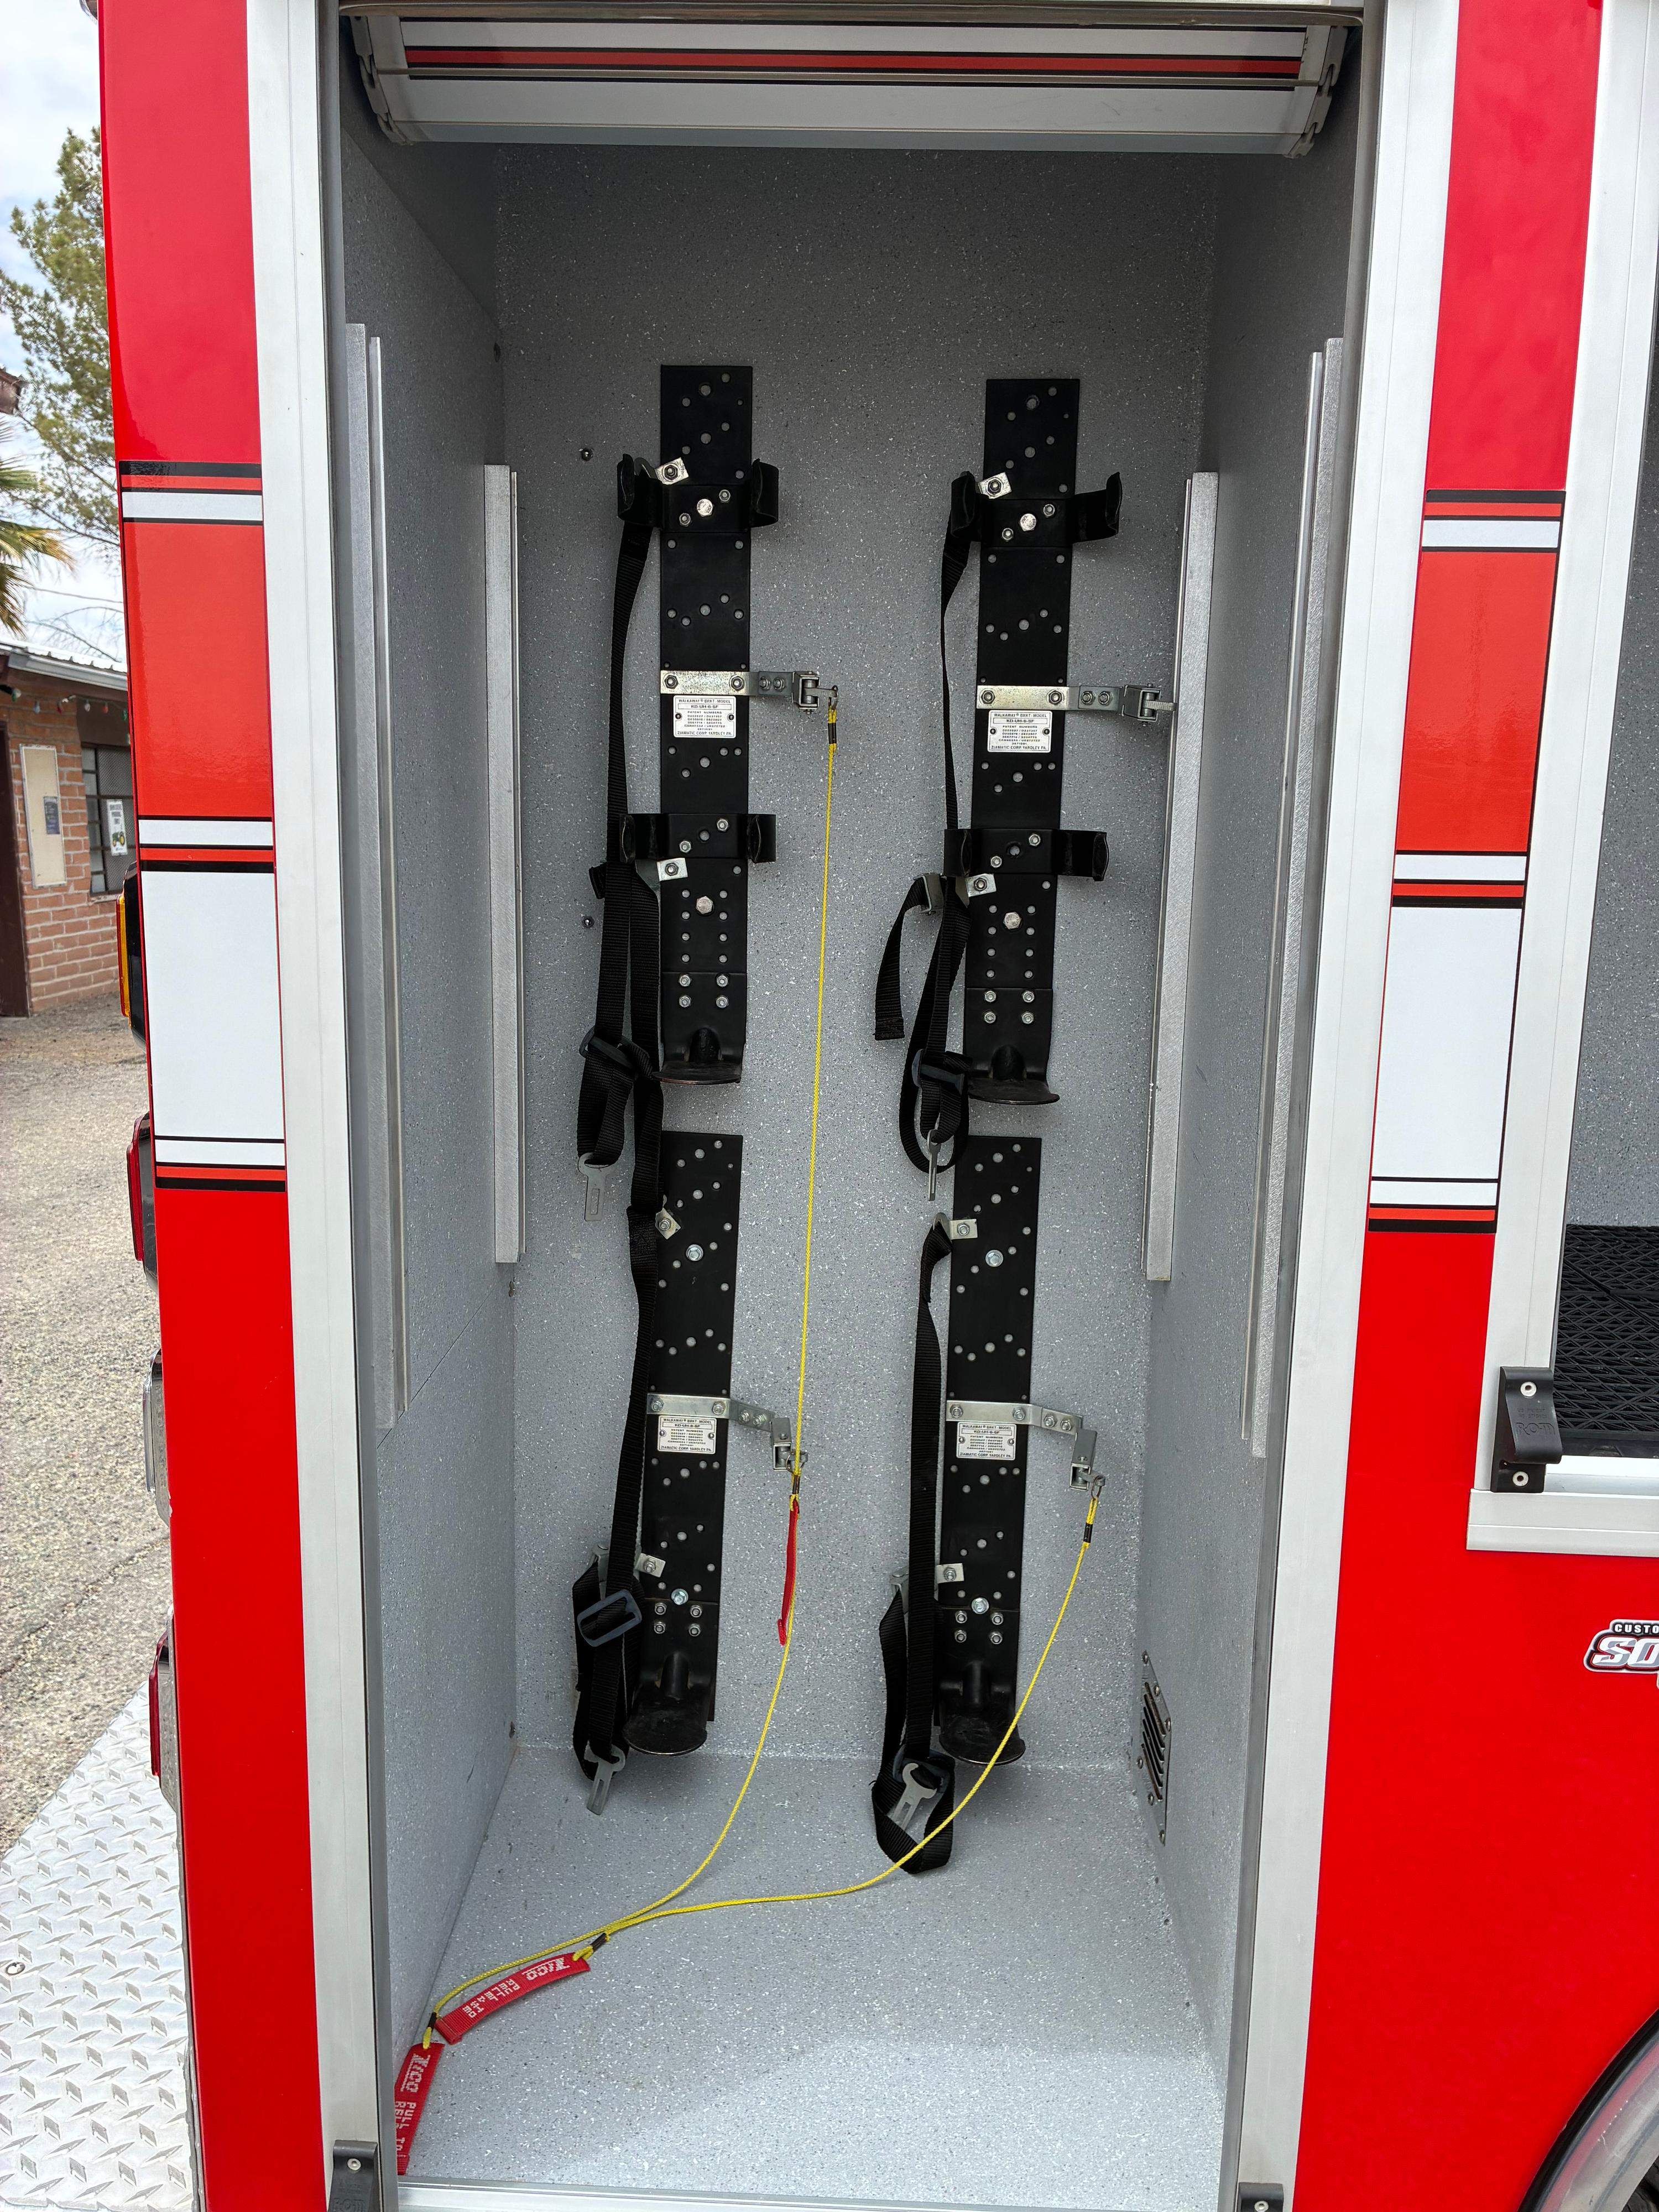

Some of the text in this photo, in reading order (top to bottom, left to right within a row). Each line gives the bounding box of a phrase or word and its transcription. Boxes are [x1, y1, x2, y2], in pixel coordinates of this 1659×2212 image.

[462, 1978, 516, 2012] RELEASE
[469, 1983, 521, 2018] PULL TO
[399, 2102, 416, 2128] PULL
